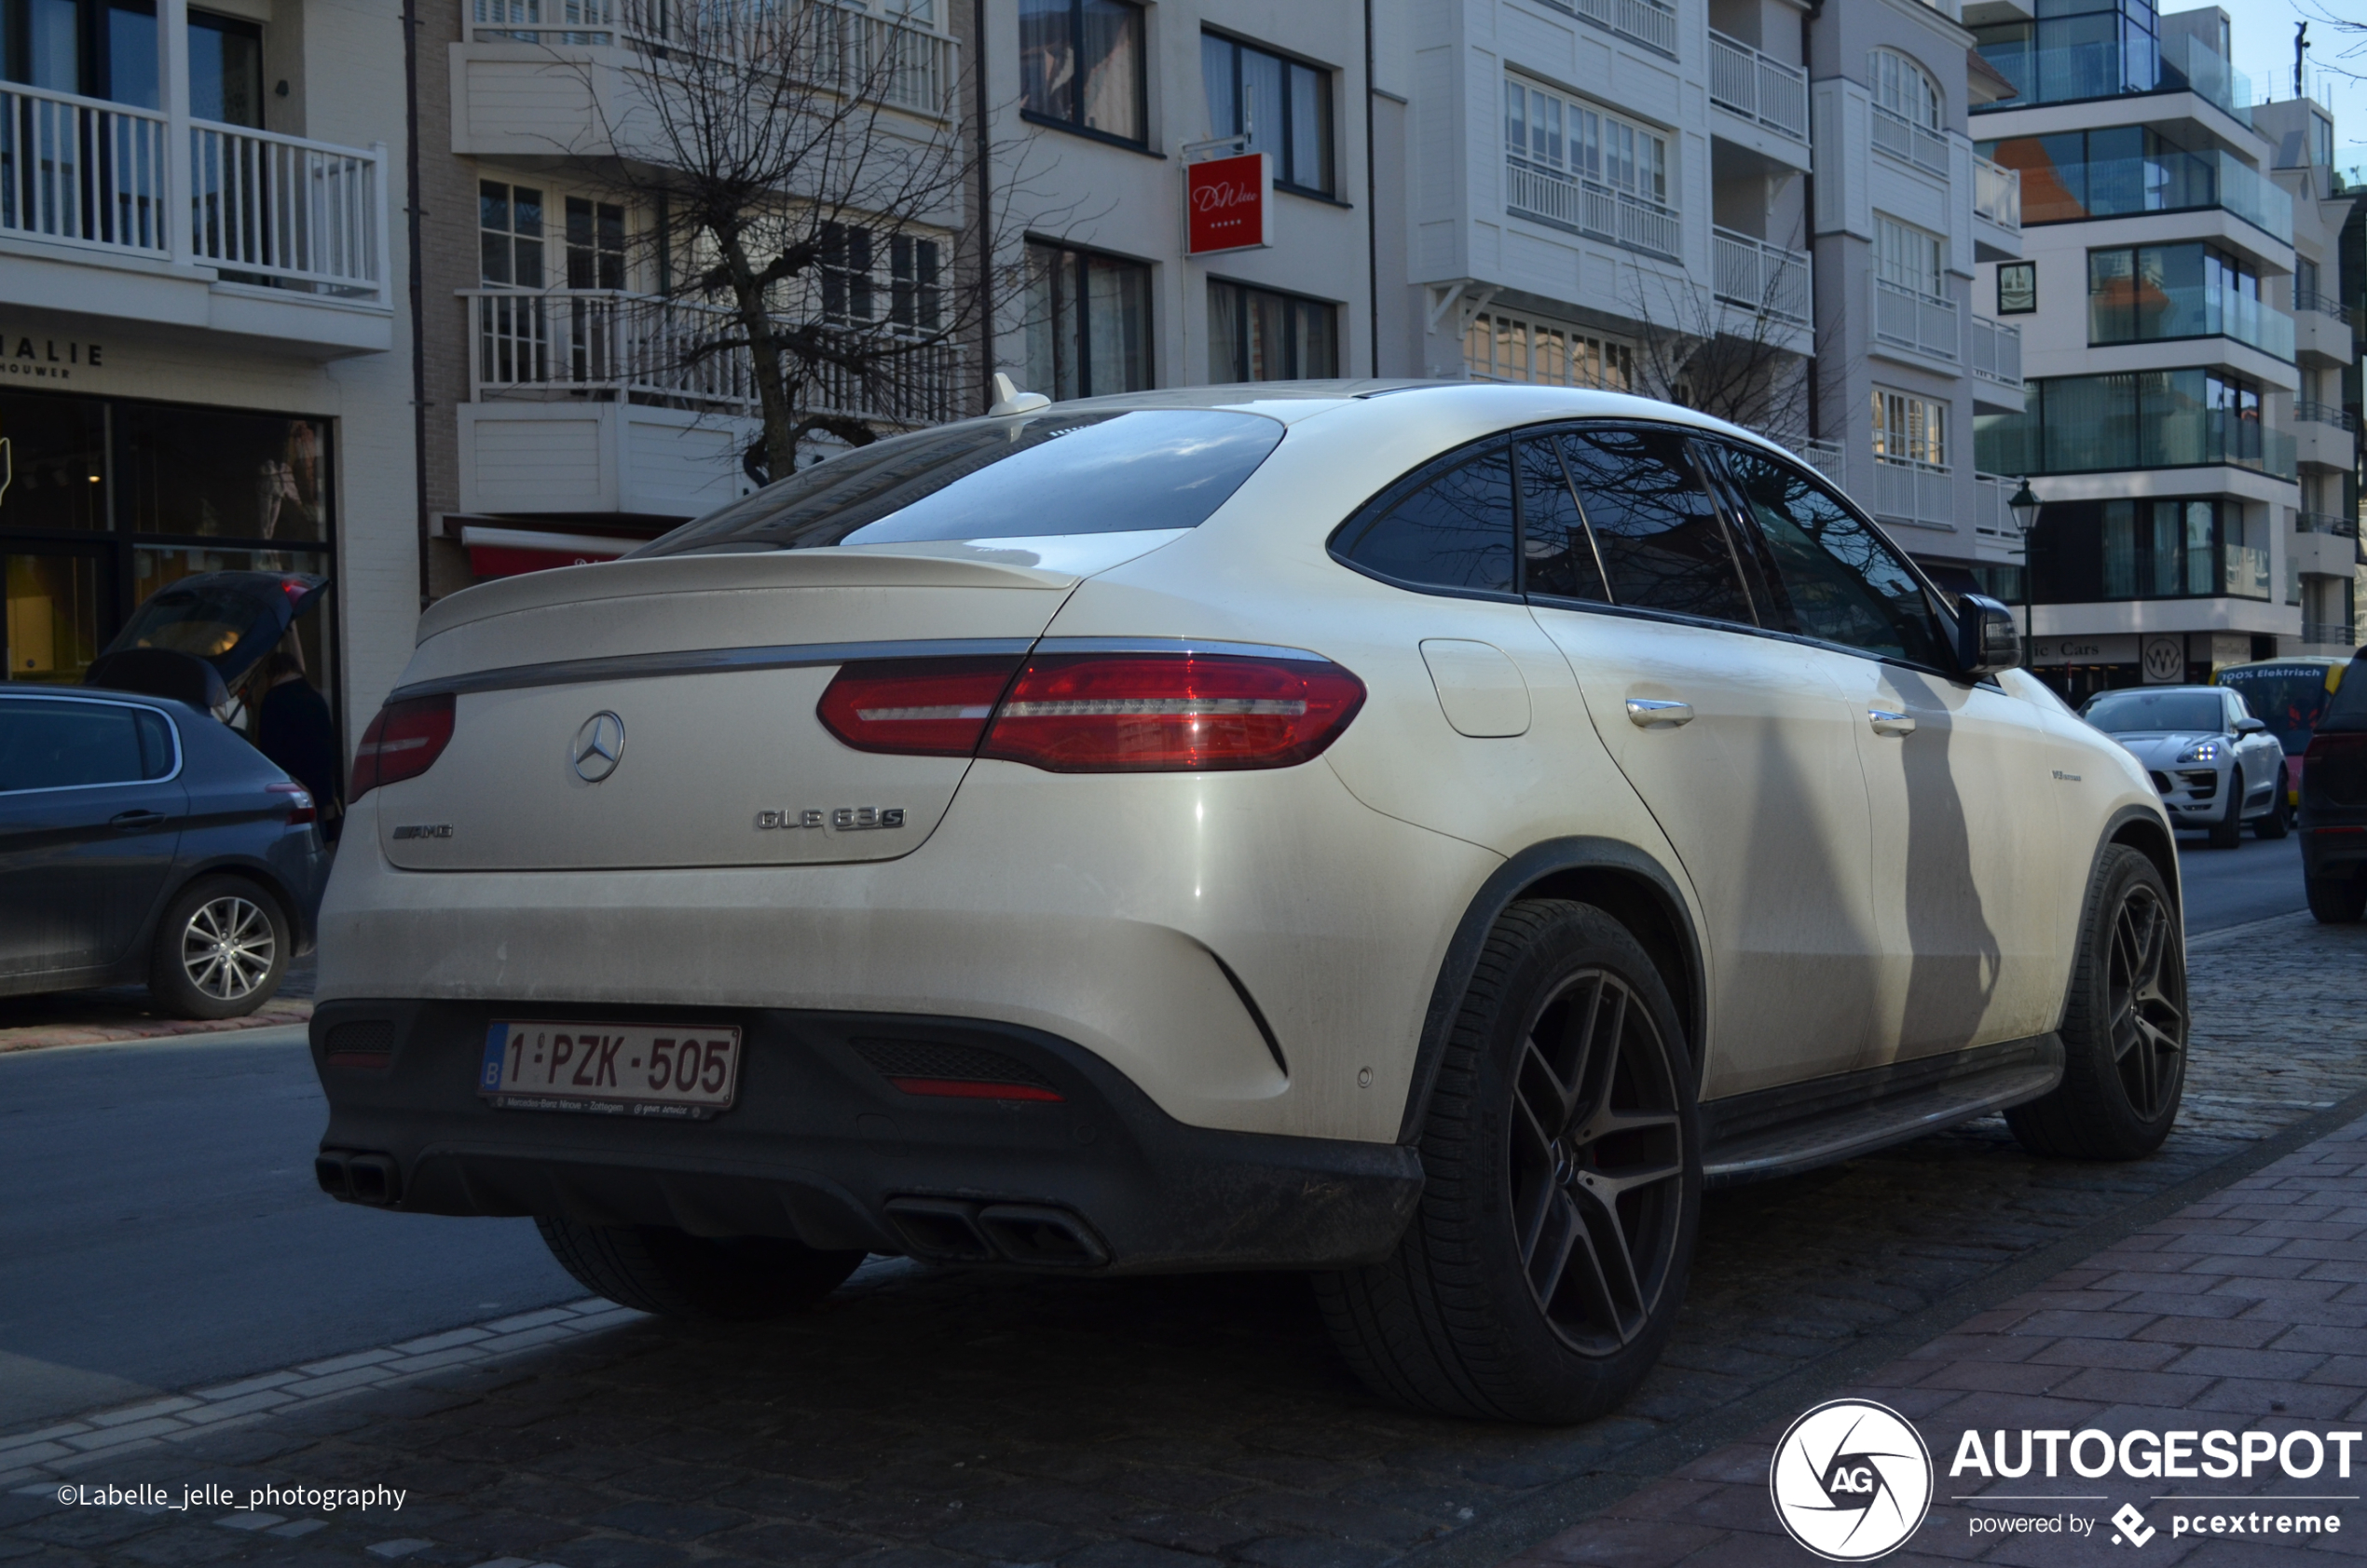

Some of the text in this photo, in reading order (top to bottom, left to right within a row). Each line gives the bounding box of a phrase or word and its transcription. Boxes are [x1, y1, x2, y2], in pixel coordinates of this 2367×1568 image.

[2060, 641, 2100, 656] Cars
[2222, 668, 2320, 681] 100% Elektrisch
[757, 809, 824, 829] GLE
[411, 824, 453, 839] AMG
[486, 1062, 499, 1084] B
[507, 1098, 557, 1109] Mercedes-Benz
[559, 1099, 581, 1110] Ninove
[590, 1101, 623, 1112] Zottegem
